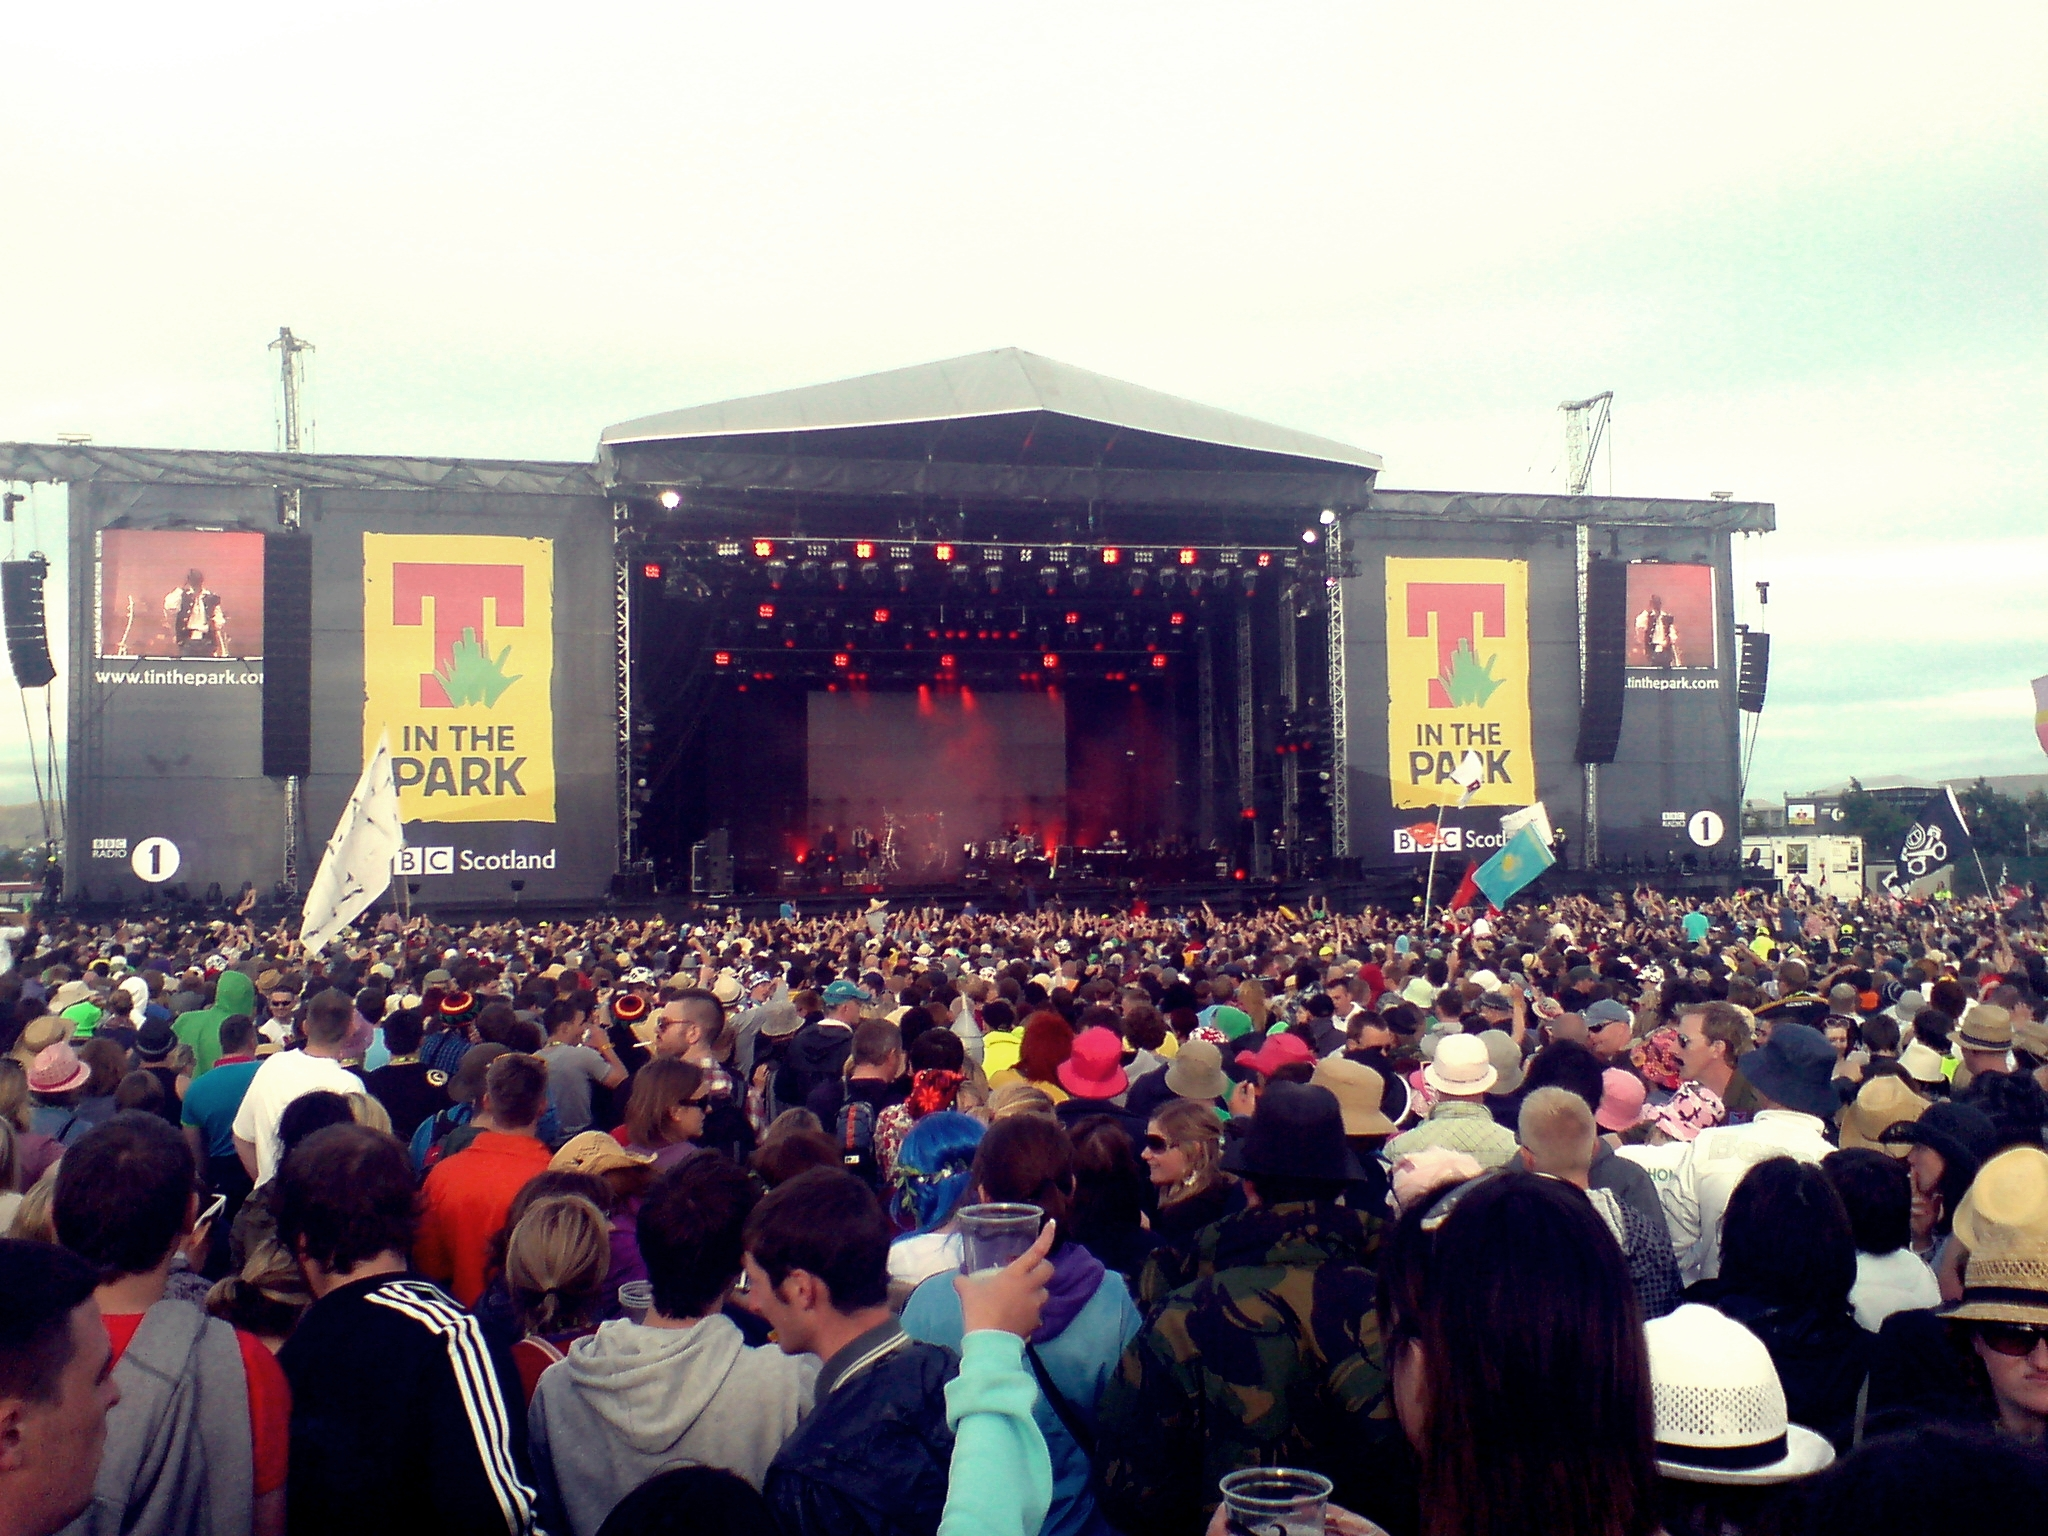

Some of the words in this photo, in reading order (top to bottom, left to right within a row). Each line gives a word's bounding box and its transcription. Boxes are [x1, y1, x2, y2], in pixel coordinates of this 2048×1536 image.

[393, 563, 524, 708] T
[1406, 583, 1505, 708] T
[404, 726, 438, 751] IN
[449, 726, 515, 751] THE
[1417, 724, 1442, 746] IN
[1450, 723, 1501, 745] THE
[391, 757, 527, 796] PARK
[1465, 831, 1507, 848] Scotl
[92, 849, 127, 858] RADIO
[396, 848, 452, 873] BC
[460, 849, 556, 870] Scotland
